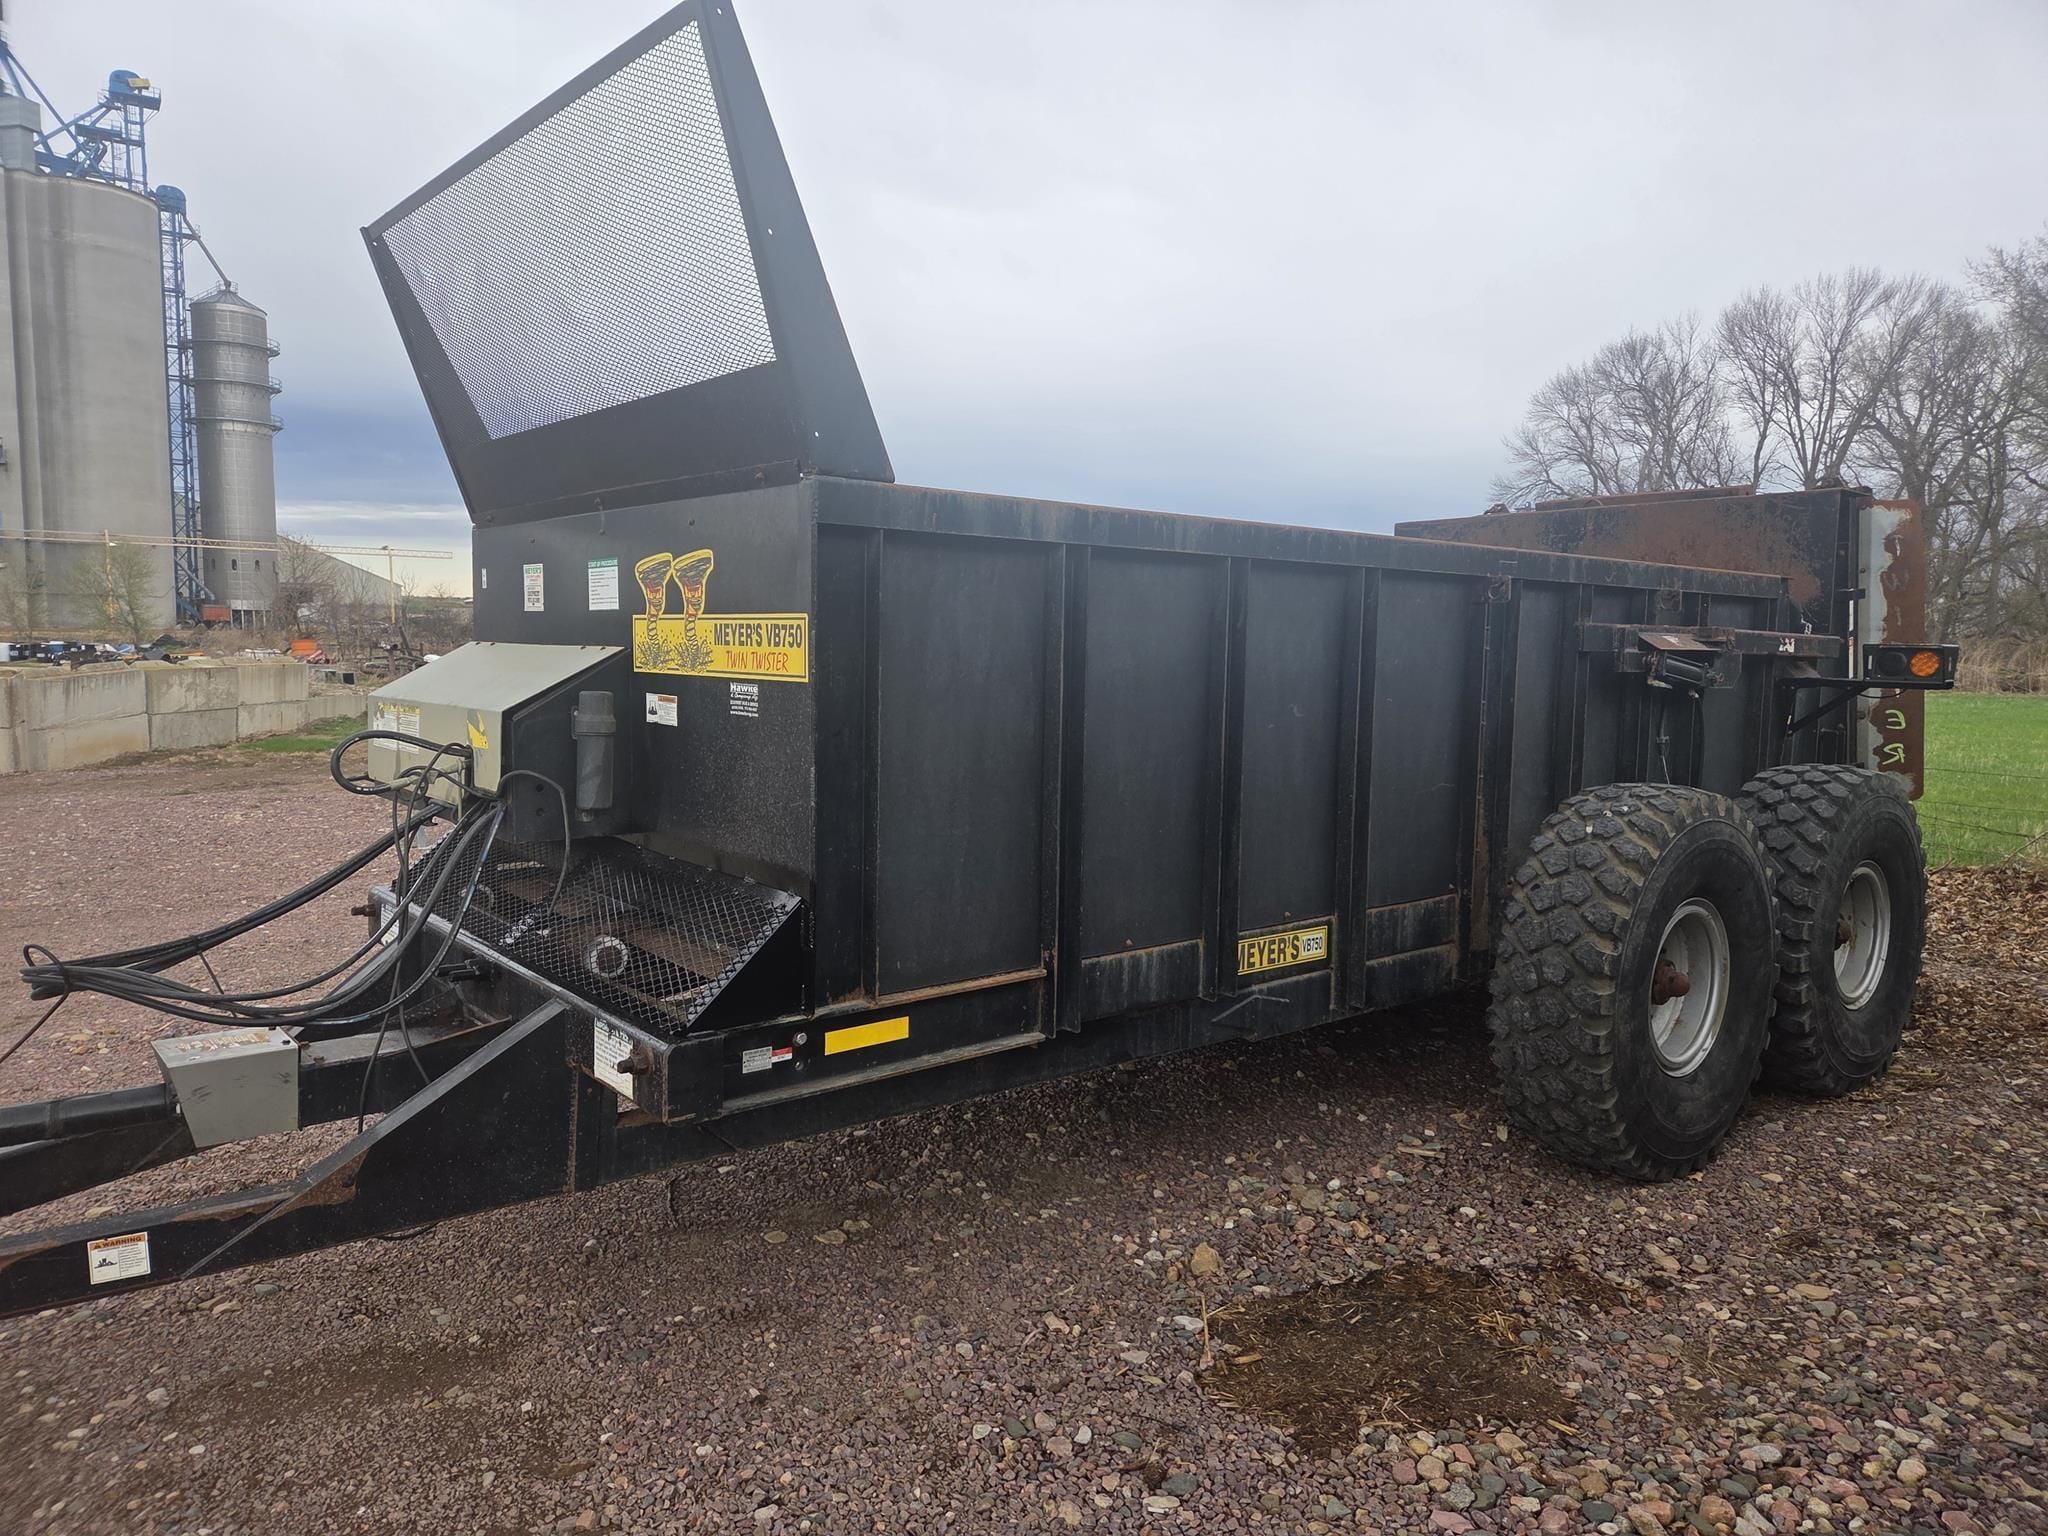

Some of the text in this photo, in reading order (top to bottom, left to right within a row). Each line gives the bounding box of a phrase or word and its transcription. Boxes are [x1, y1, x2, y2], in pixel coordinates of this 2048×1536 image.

[713, 622, 803, 649] MEYER'S VB750
[725, 650, 789, 673] TWIN TWISTER
[1302, 936, 1323, 953] VB750
[103, 1236, 142, 1248] WARNING
